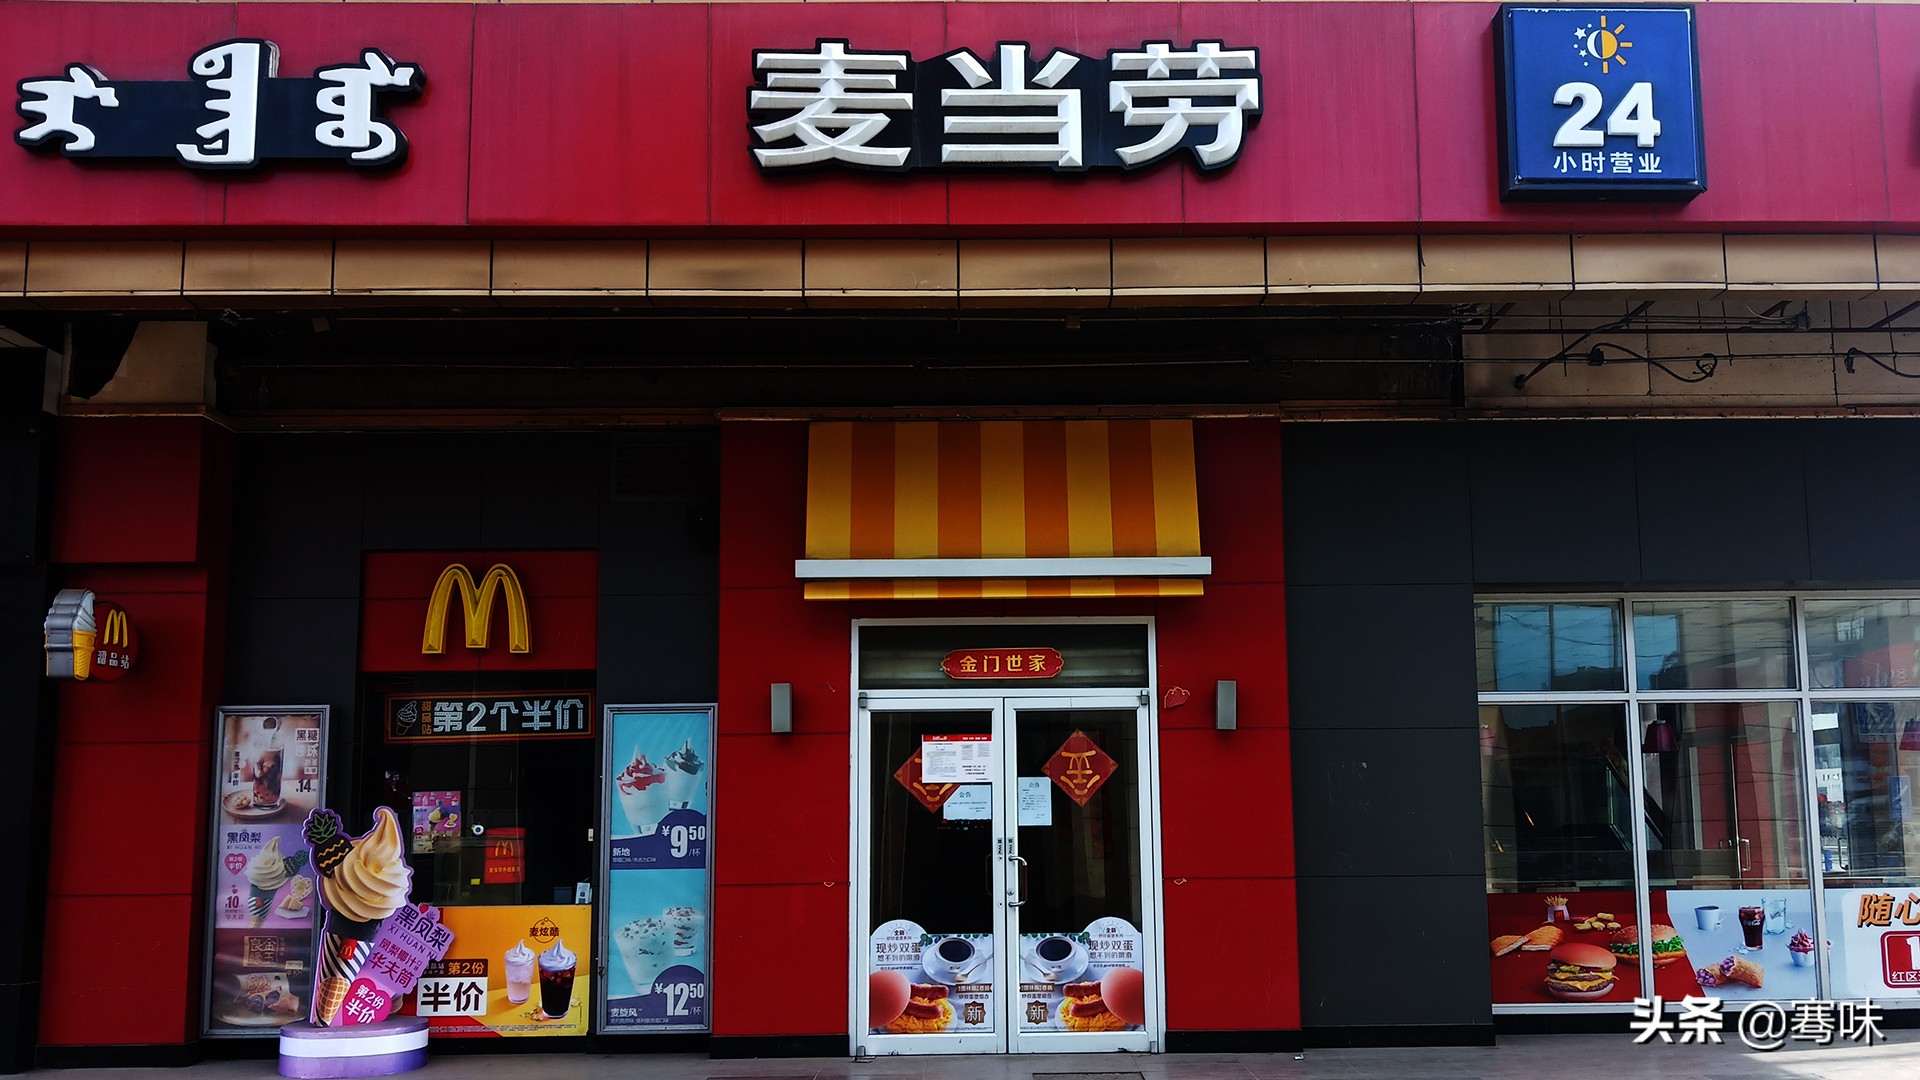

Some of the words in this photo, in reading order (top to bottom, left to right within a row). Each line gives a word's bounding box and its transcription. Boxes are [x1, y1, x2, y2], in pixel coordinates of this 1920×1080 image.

[751, 42, 1259, 168] 麦当劳
[1552, 81, 1662, 148] 24
[1553, 151, 1663, 174] 小时营业
[97, 650, 130, 670] 甜品站
[960, 654, 1046, 673] 金门世家
[421, 701, 432, 735] 甜品站
[433, 698, 584, 732] 第2个半价
[296, 729, 318, 741] 黑糖
[227, 832, 261, 844] 黑凤梨
[228, 862, 243, 870] 半价
[394, 904, 451, 952] 黑凤梨
[529, 926, 560, 938] 麦炫酷
[388, 924, 398, 936] XI
[399, 933, 426, 954] HUAN
[876, 942, 921, 954] 现炒双蛋
[1088, 940, 1134, 951] 现炒双蛋
[378, 938, 417, 968] 凤梨椰汁
[368, 951, 415, 989] 华夫筒
[447, 962, 485, 975] 第2份
[1891, 971, 1920, 982] 红区
[355, 984, 385, 1010] 第2份
[421, 982, 484, 1012] 半价
[345, 998, 376, 1024] 半价
[967, 1005, 983, 1021] 新
[1029, 1005, 1045, 1021] 新
